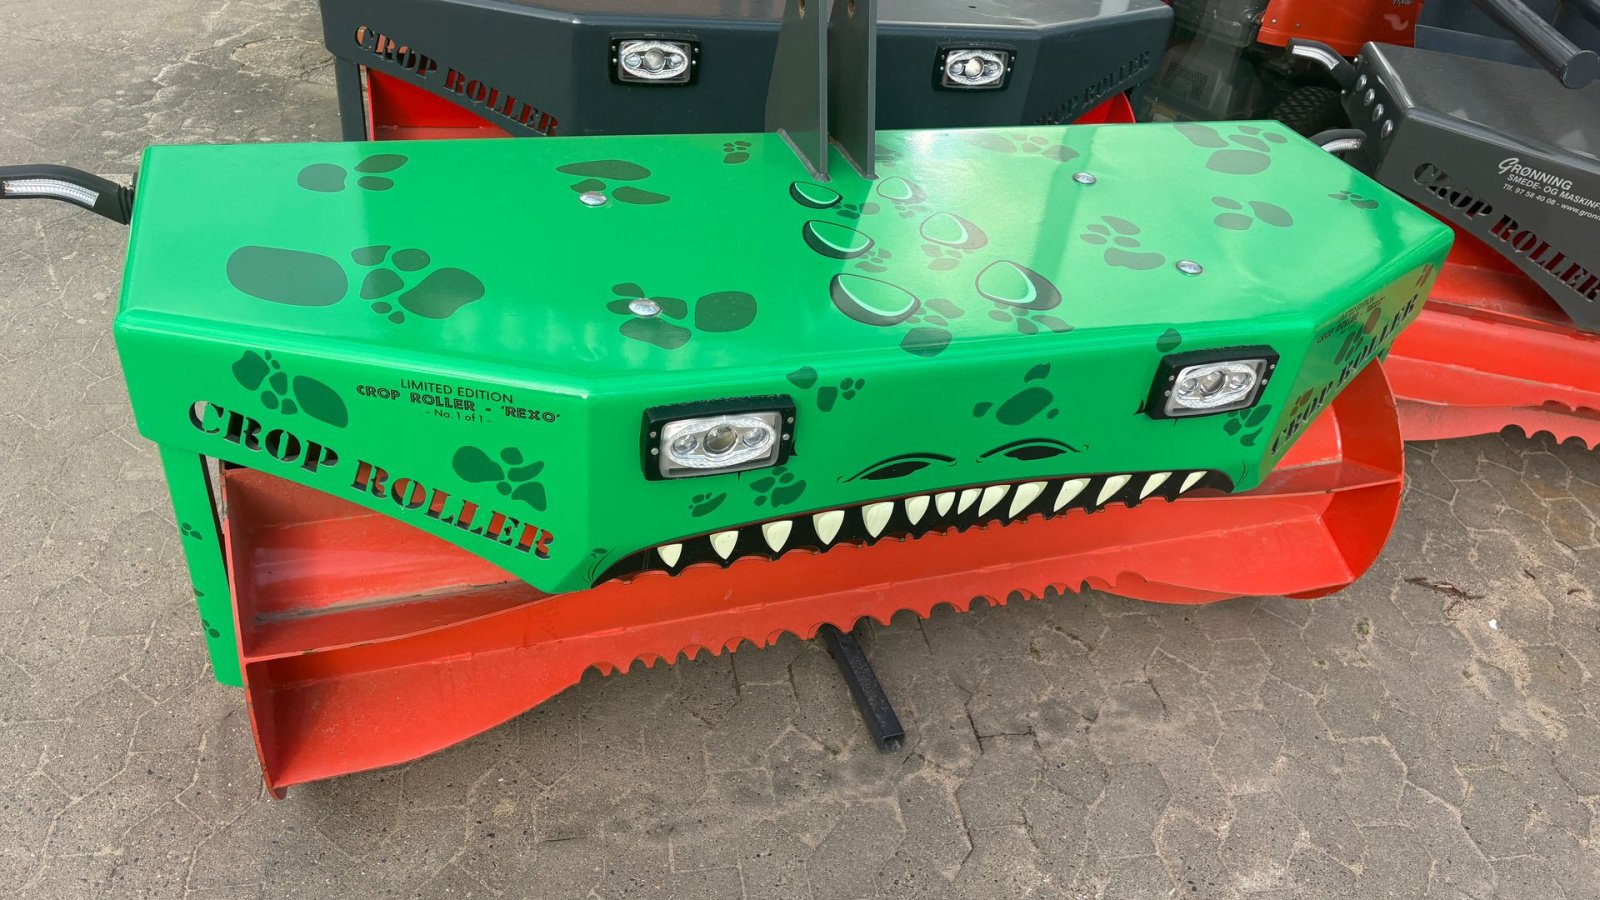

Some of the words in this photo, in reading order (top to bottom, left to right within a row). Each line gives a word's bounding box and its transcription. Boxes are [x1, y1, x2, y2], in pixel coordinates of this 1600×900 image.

[354, 25, 437, 79] CROP
[443, 66, 560, 137] ROLLER
[1498, 157, 1573, 190] GRØNNING
[1412, 162, 1493, 220] CROP
[1515, 187, 1525, 195] 97
[1536, 194, 1546, 202] 40
[1543, 185, 1558, 196] OG
[1559, 190, 1600, 210] MASKINF
[356, 384, 401, 400] CROP
[410, 392, 475, 412] ROLLER
[400, 378, 453, 396] LIMITED
[457, 386, 513, 404] EDITION
[434, 408, 453, 419] No.
[456, 411, 461, 420] 1
[464, 413, 476, 422] of
[479, 414, 484, 423] 1
[188, 400, 339, 474] CROP
[350, 459, 555, 560] ROLLER
